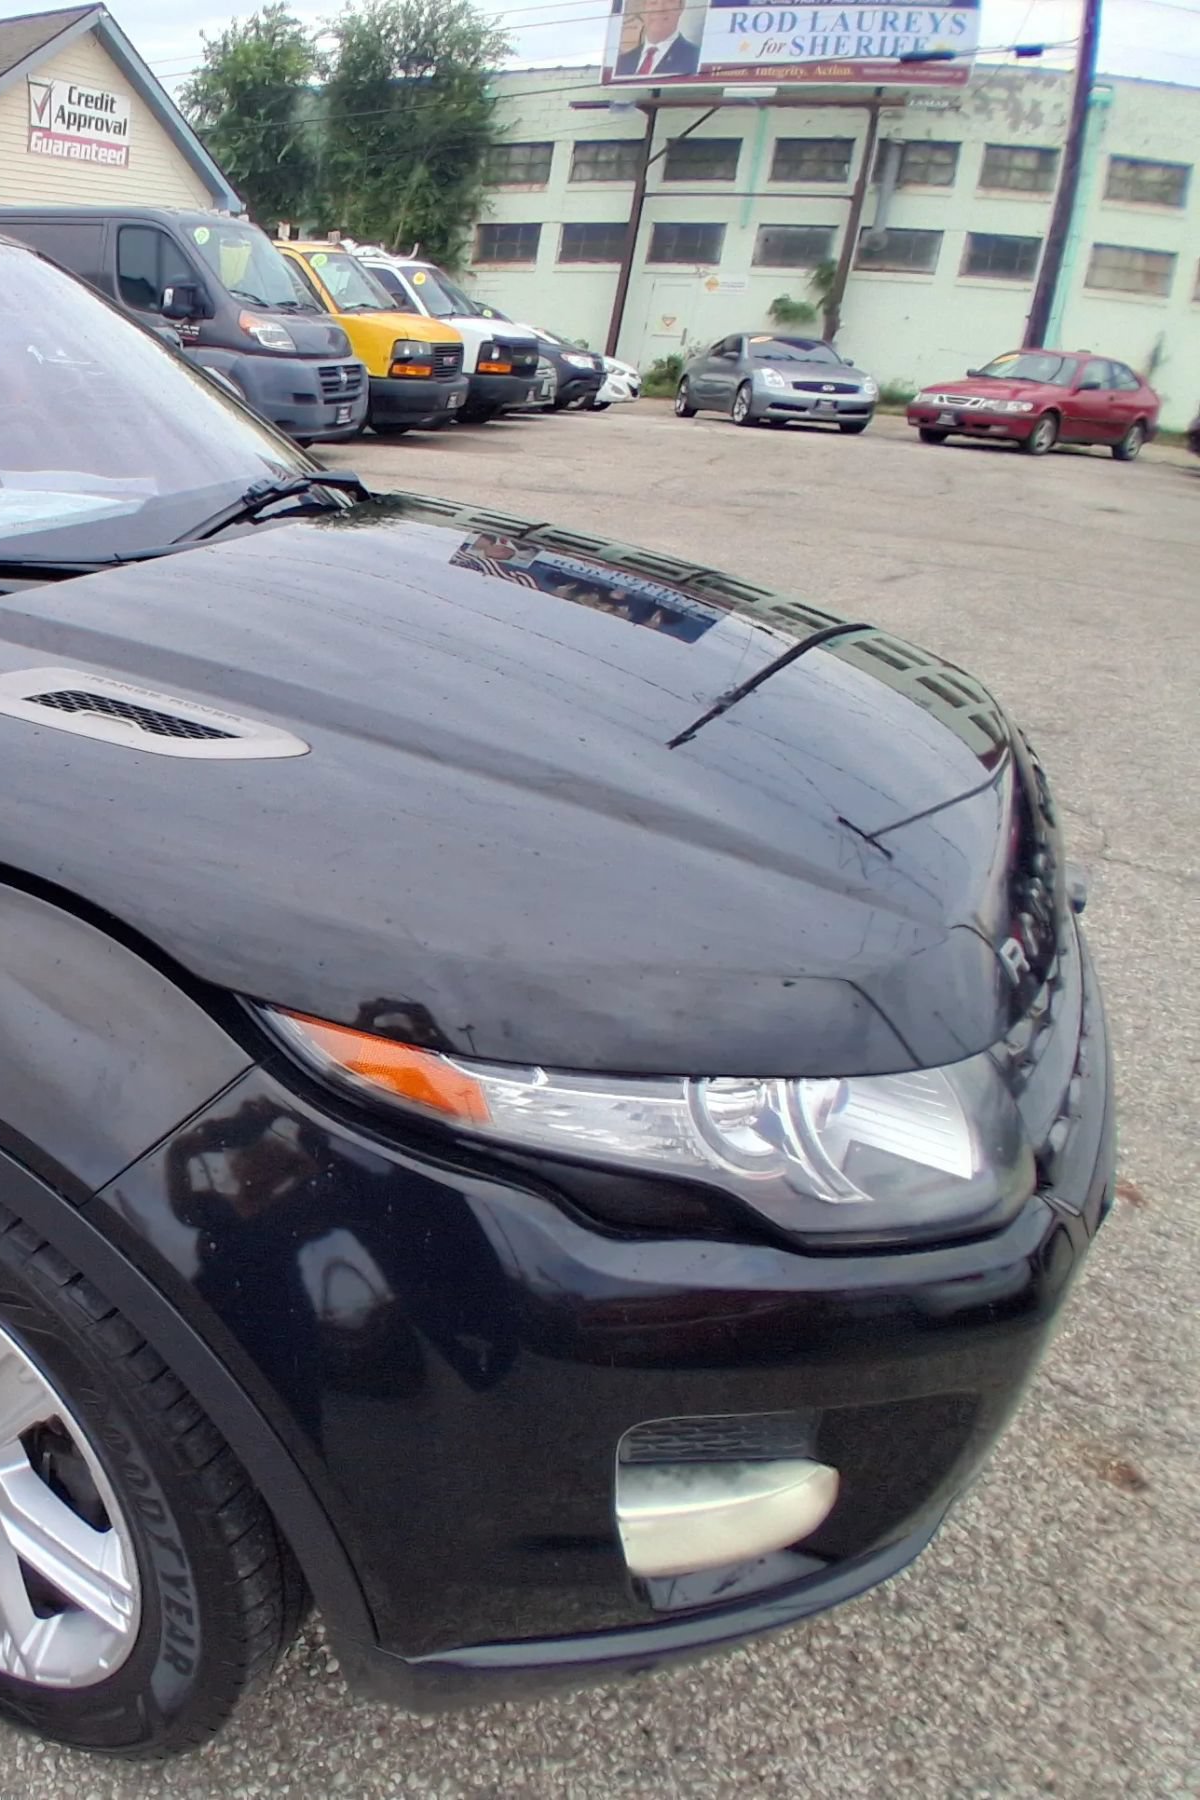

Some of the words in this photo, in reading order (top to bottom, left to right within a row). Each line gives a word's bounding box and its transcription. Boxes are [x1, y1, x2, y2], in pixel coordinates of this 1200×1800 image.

[728, 11, 798, 34] ROD
[808, 11, 968, 36] LAUREYS
[758, 38, 787, 58] for
[789, 34, 930, 58] SHERIFF
[67, 86, 117, 114] Credit
[54, 104, 128, 136] Approval
[30, 131, 127, 166] Guaranteed
